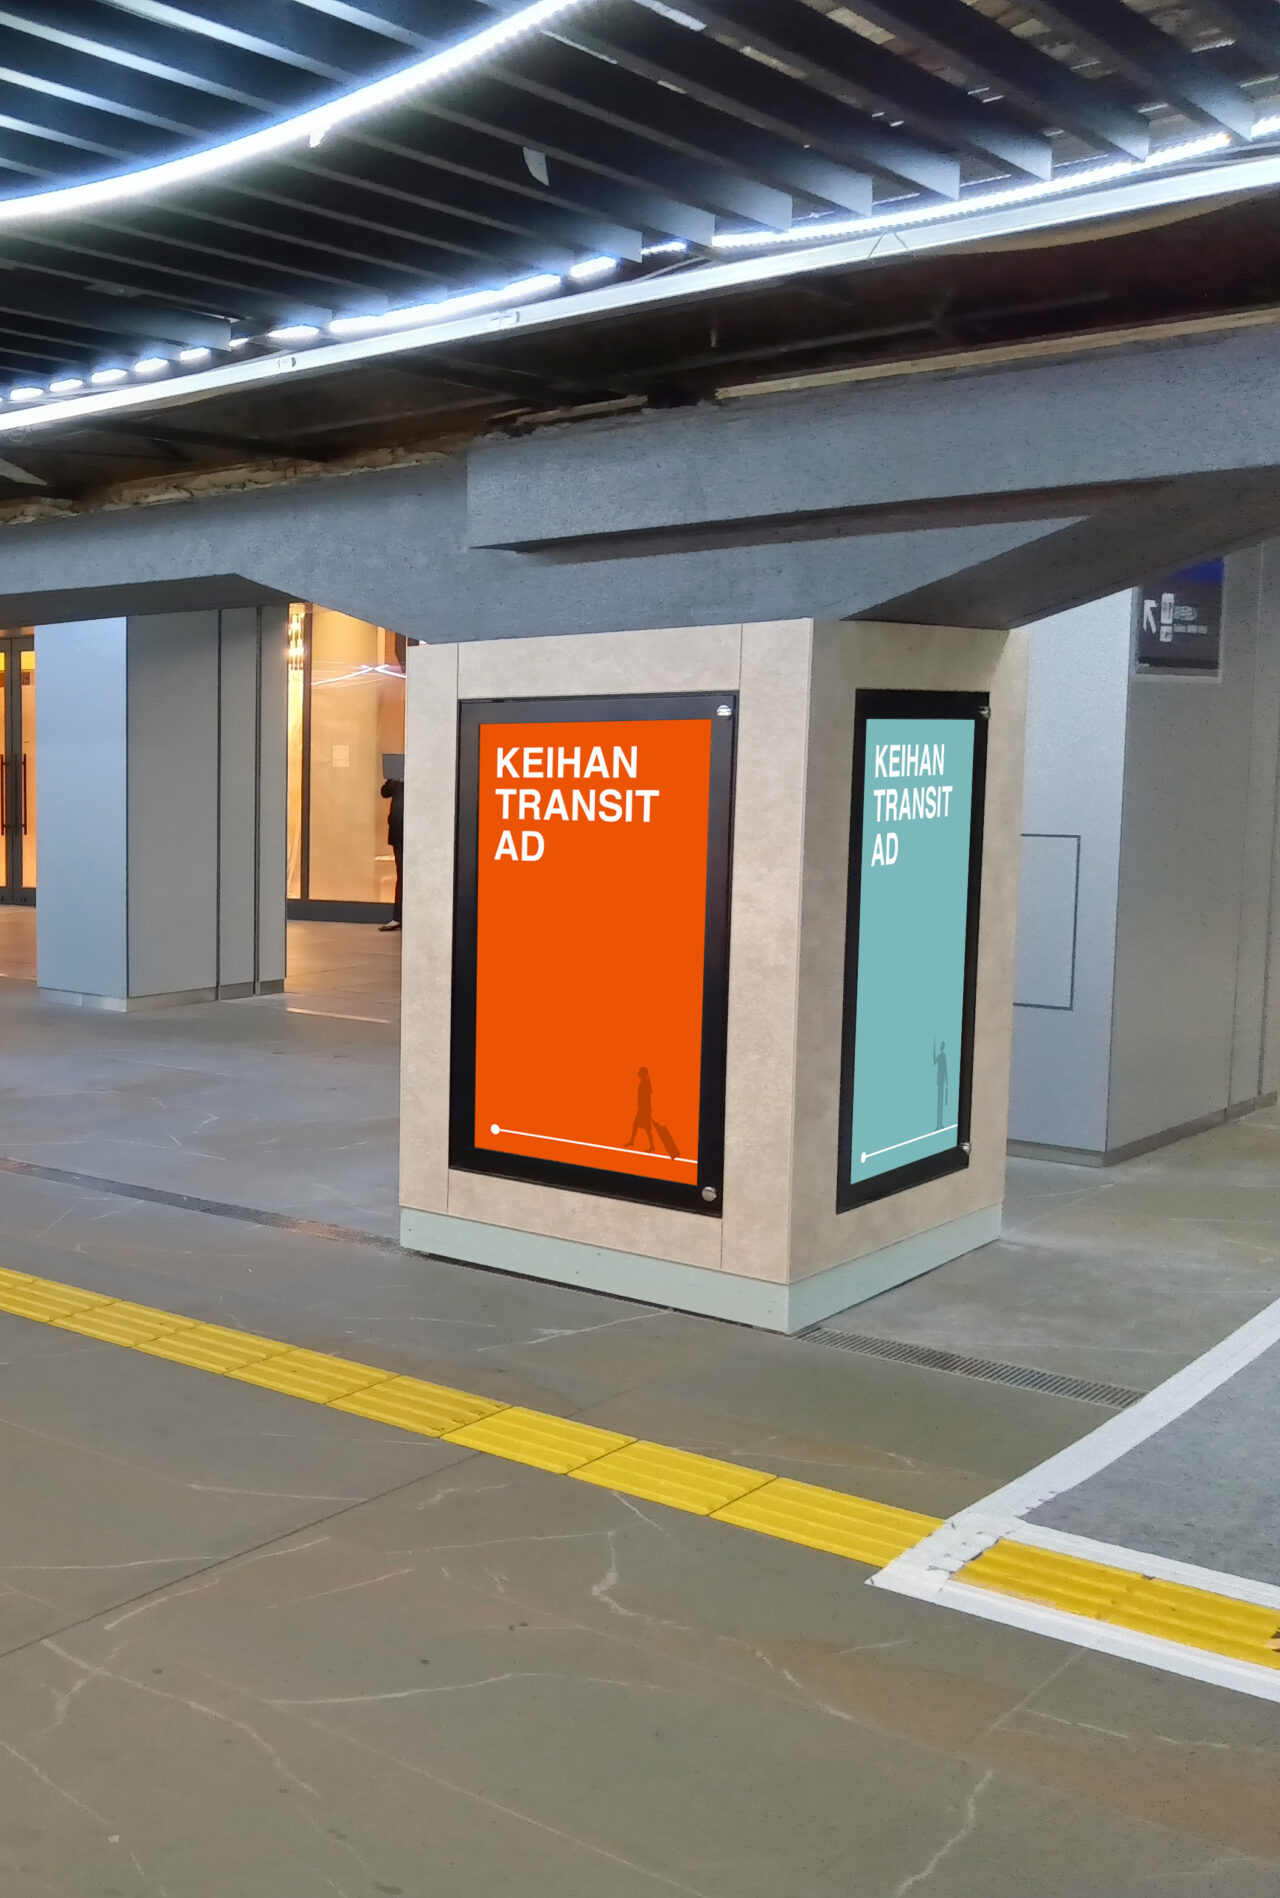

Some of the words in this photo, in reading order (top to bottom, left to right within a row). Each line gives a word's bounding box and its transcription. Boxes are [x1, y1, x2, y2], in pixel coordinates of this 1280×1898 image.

[495, 746, 638, 779] KEIHAN
[874, 744, 945, 779] KEIHAN
[495, 788, 660, 823] TRANSIT
[873, 785, 953, 823] TRANSIT
[494, 830, 546, 862] AD
[870, 832, 899, 867] AD
